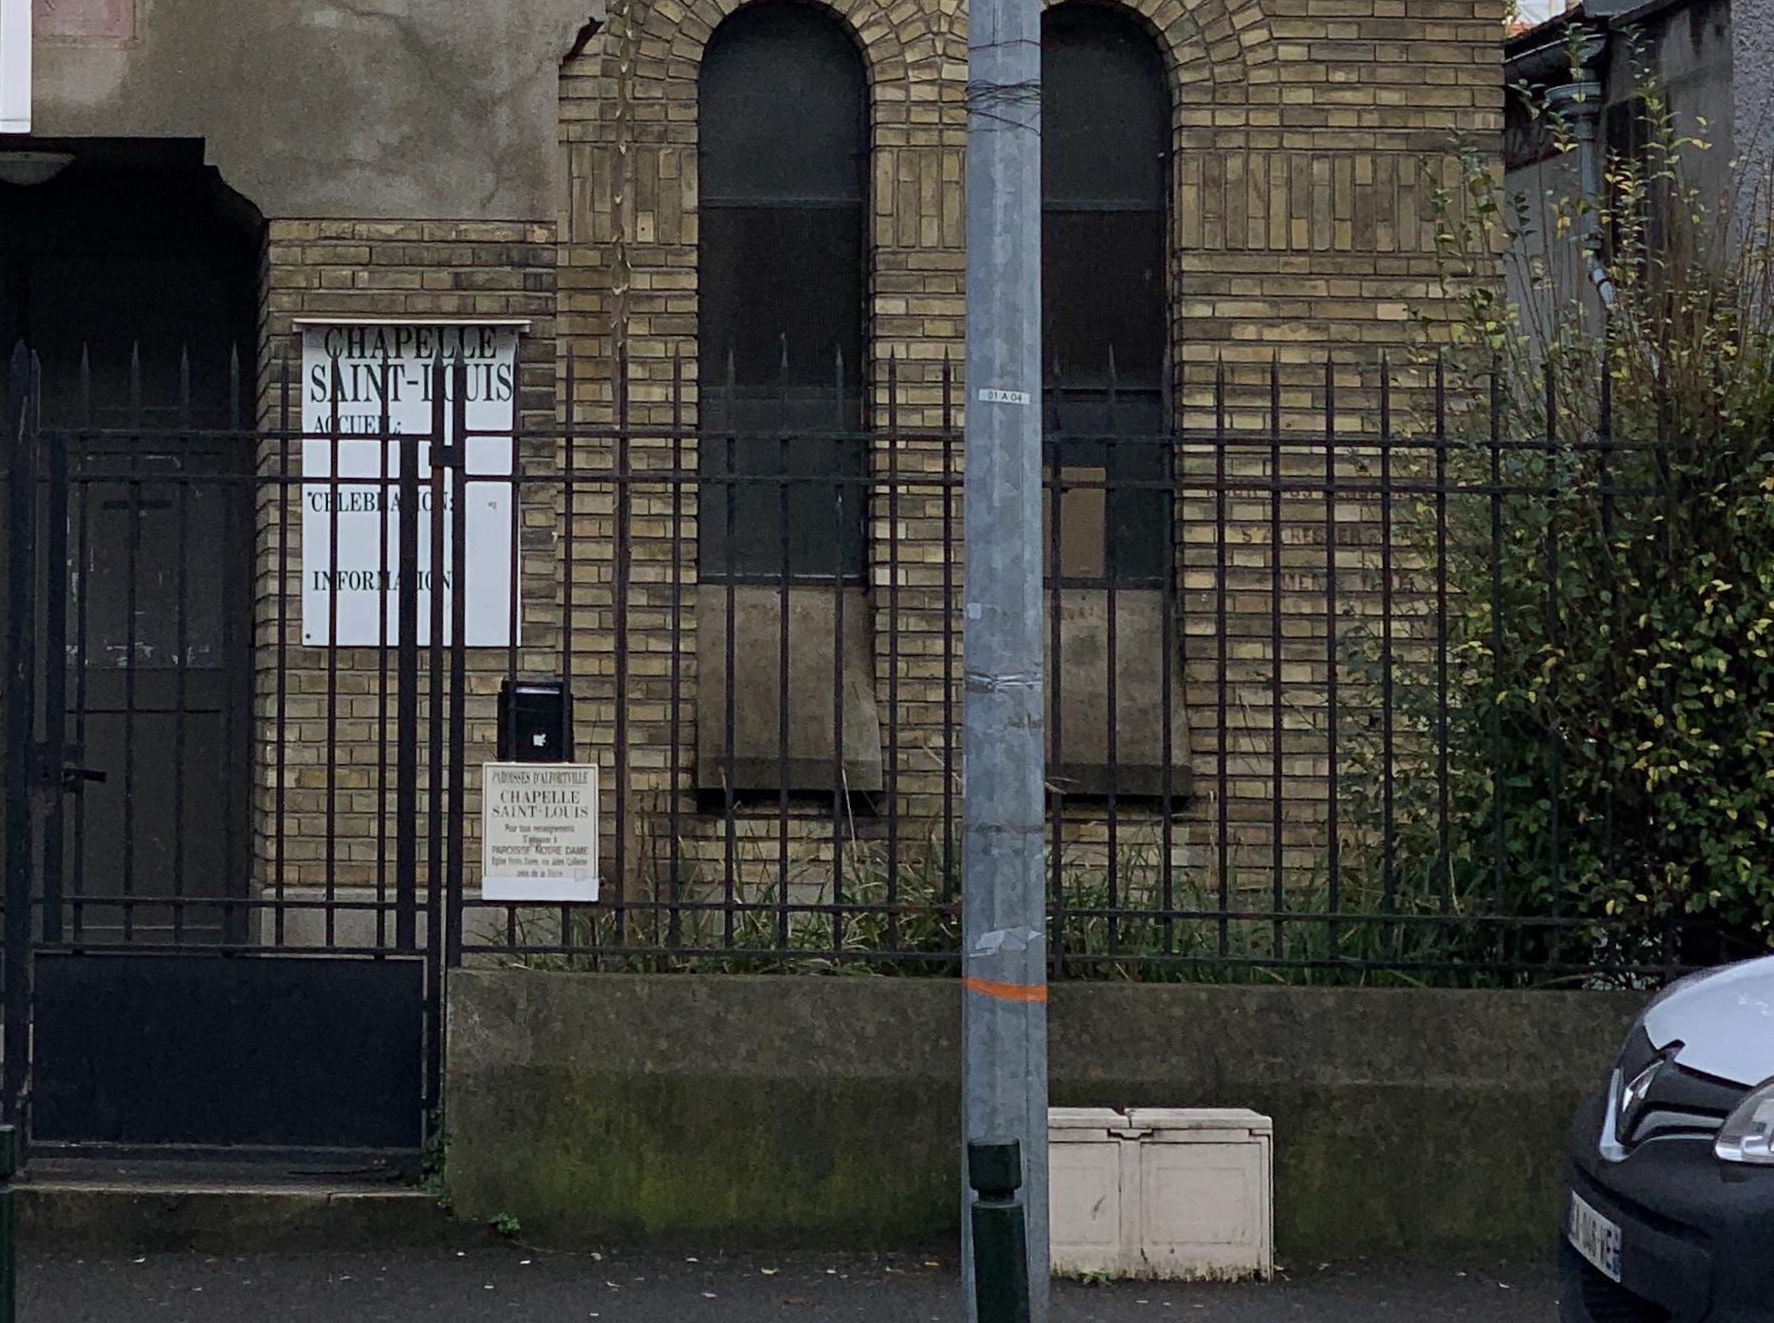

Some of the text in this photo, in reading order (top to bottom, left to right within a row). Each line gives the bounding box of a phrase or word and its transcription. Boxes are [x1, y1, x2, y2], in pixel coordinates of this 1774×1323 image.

[324, 326, 497, 359] CHAPELLE
[500, 790, 581, 804] CHAPELLE
[491, 805, 589, 819] SAINT-LOUIS
